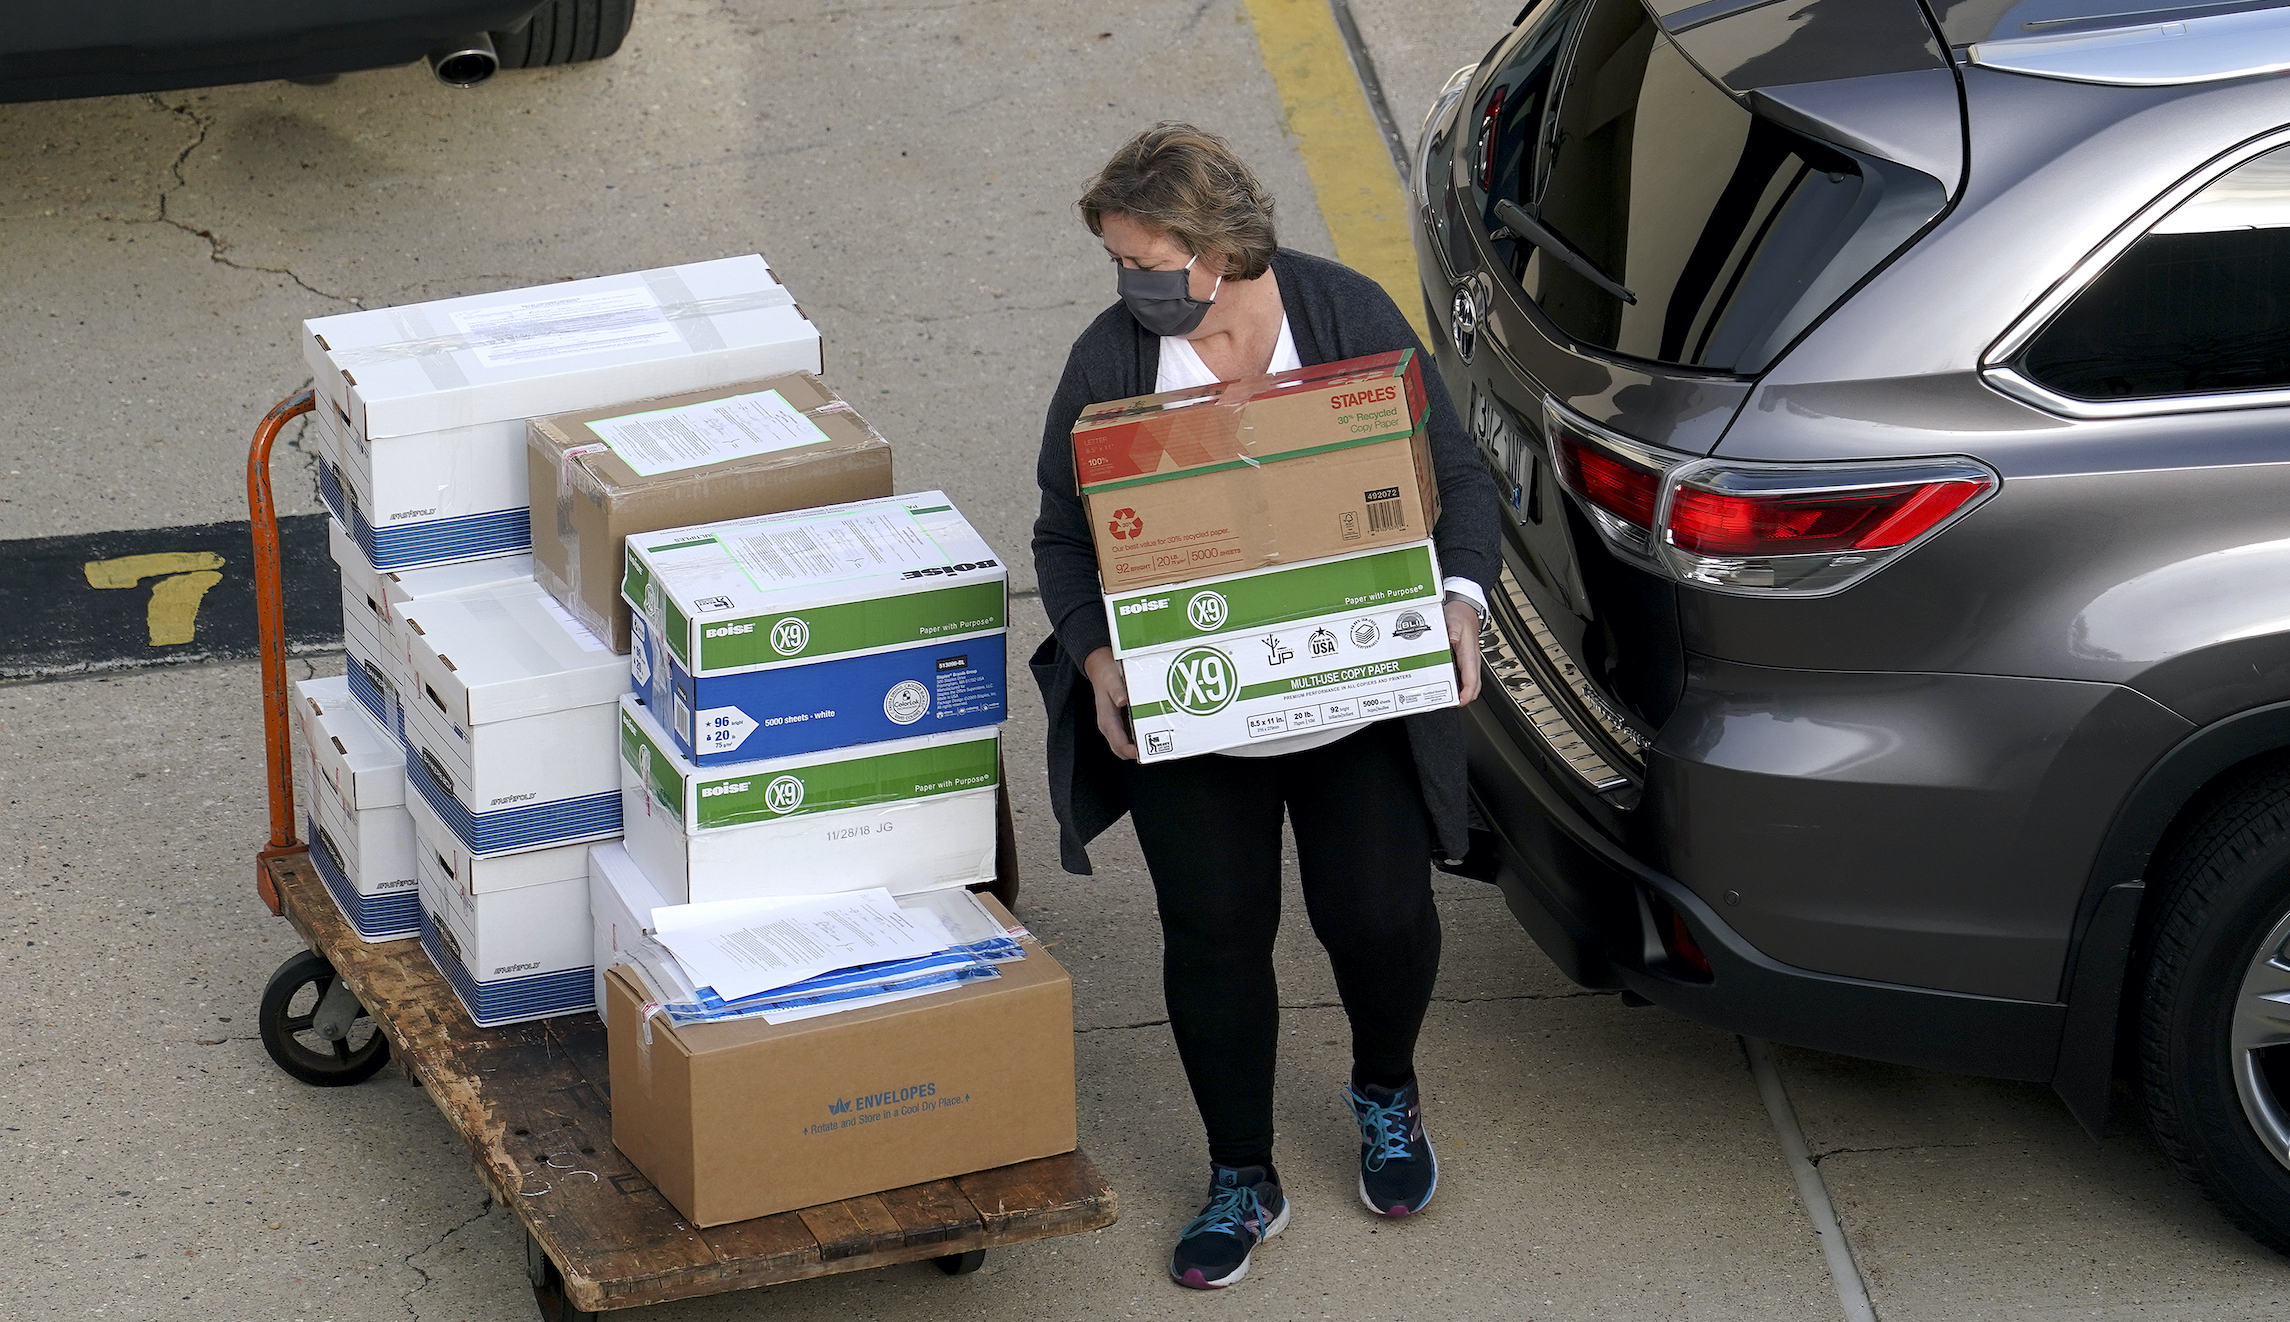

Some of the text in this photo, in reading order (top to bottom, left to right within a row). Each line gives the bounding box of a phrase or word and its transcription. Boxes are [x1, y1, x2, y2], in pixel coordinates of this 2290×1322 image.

[1331, 386, 1396, 410] STAPLES
[1338, 407, 1398, 425] 30% Recycled
[1351, 419, 1400, 434] Copy Paper
[1084, 437, 1107, 446] LETTER
[1088, 457, 1109, 467] 100%
[1368, 489, 1398, 500] 492072
[1125, 543, 1139, 551] best
[1140, 540, 1156, 548] value
[1183, 530, 1209, 541] recycled
[1157, 556, 1171, 567] 20
[1191, 547, 1241, 561] 5000 SHEETS
[1116, 562, 1151, 574] 92 BRIGHT
[84, 552, 226, 647] 7
[1345, 596, 1367, 605] Paper
[1369, 592, 1385, 601] with
[920, 626, 940, 634] Paper
[942, 622, 958, 630] with
[1312, 640, 1336, 655] USA
[1268, 651, 1294, 666] UP
[1290, 661, 1400, 690] MULTI-USE COPY PAPER
[1283, 693, 1305, 701] PREMIUM
[1306, 687, 1340, 697] PERFORMANCE
[1357, 680, 1378, 688] COPIERS
[1388, 674, 1412, 682] PRINTERS
[1363, 699, 1379, 707] 5000
[715, 716, 729, 727] 96
[765, 710, 836, 727] 5000 sheets white
[715, 730, 730, 741] 20
[915, 783, 936, 792] Paper
[938, 780, 952, 788] with
[827, 822, 893, 841] 11/28/18 JG
[856, 1082, 936, 1111] ENVELOPES
[811, 1121, 838, 1134] Rotate
[841, 1118, 856, 1128] and
[859, 1113, 881, 1125] Store
[884, 1110, 891, 1119] in
[901, 1104, 919, 1115] Cool
[922, 1101, 937, 1112] Dry
[939, 1096, 963, 1108] Place.
